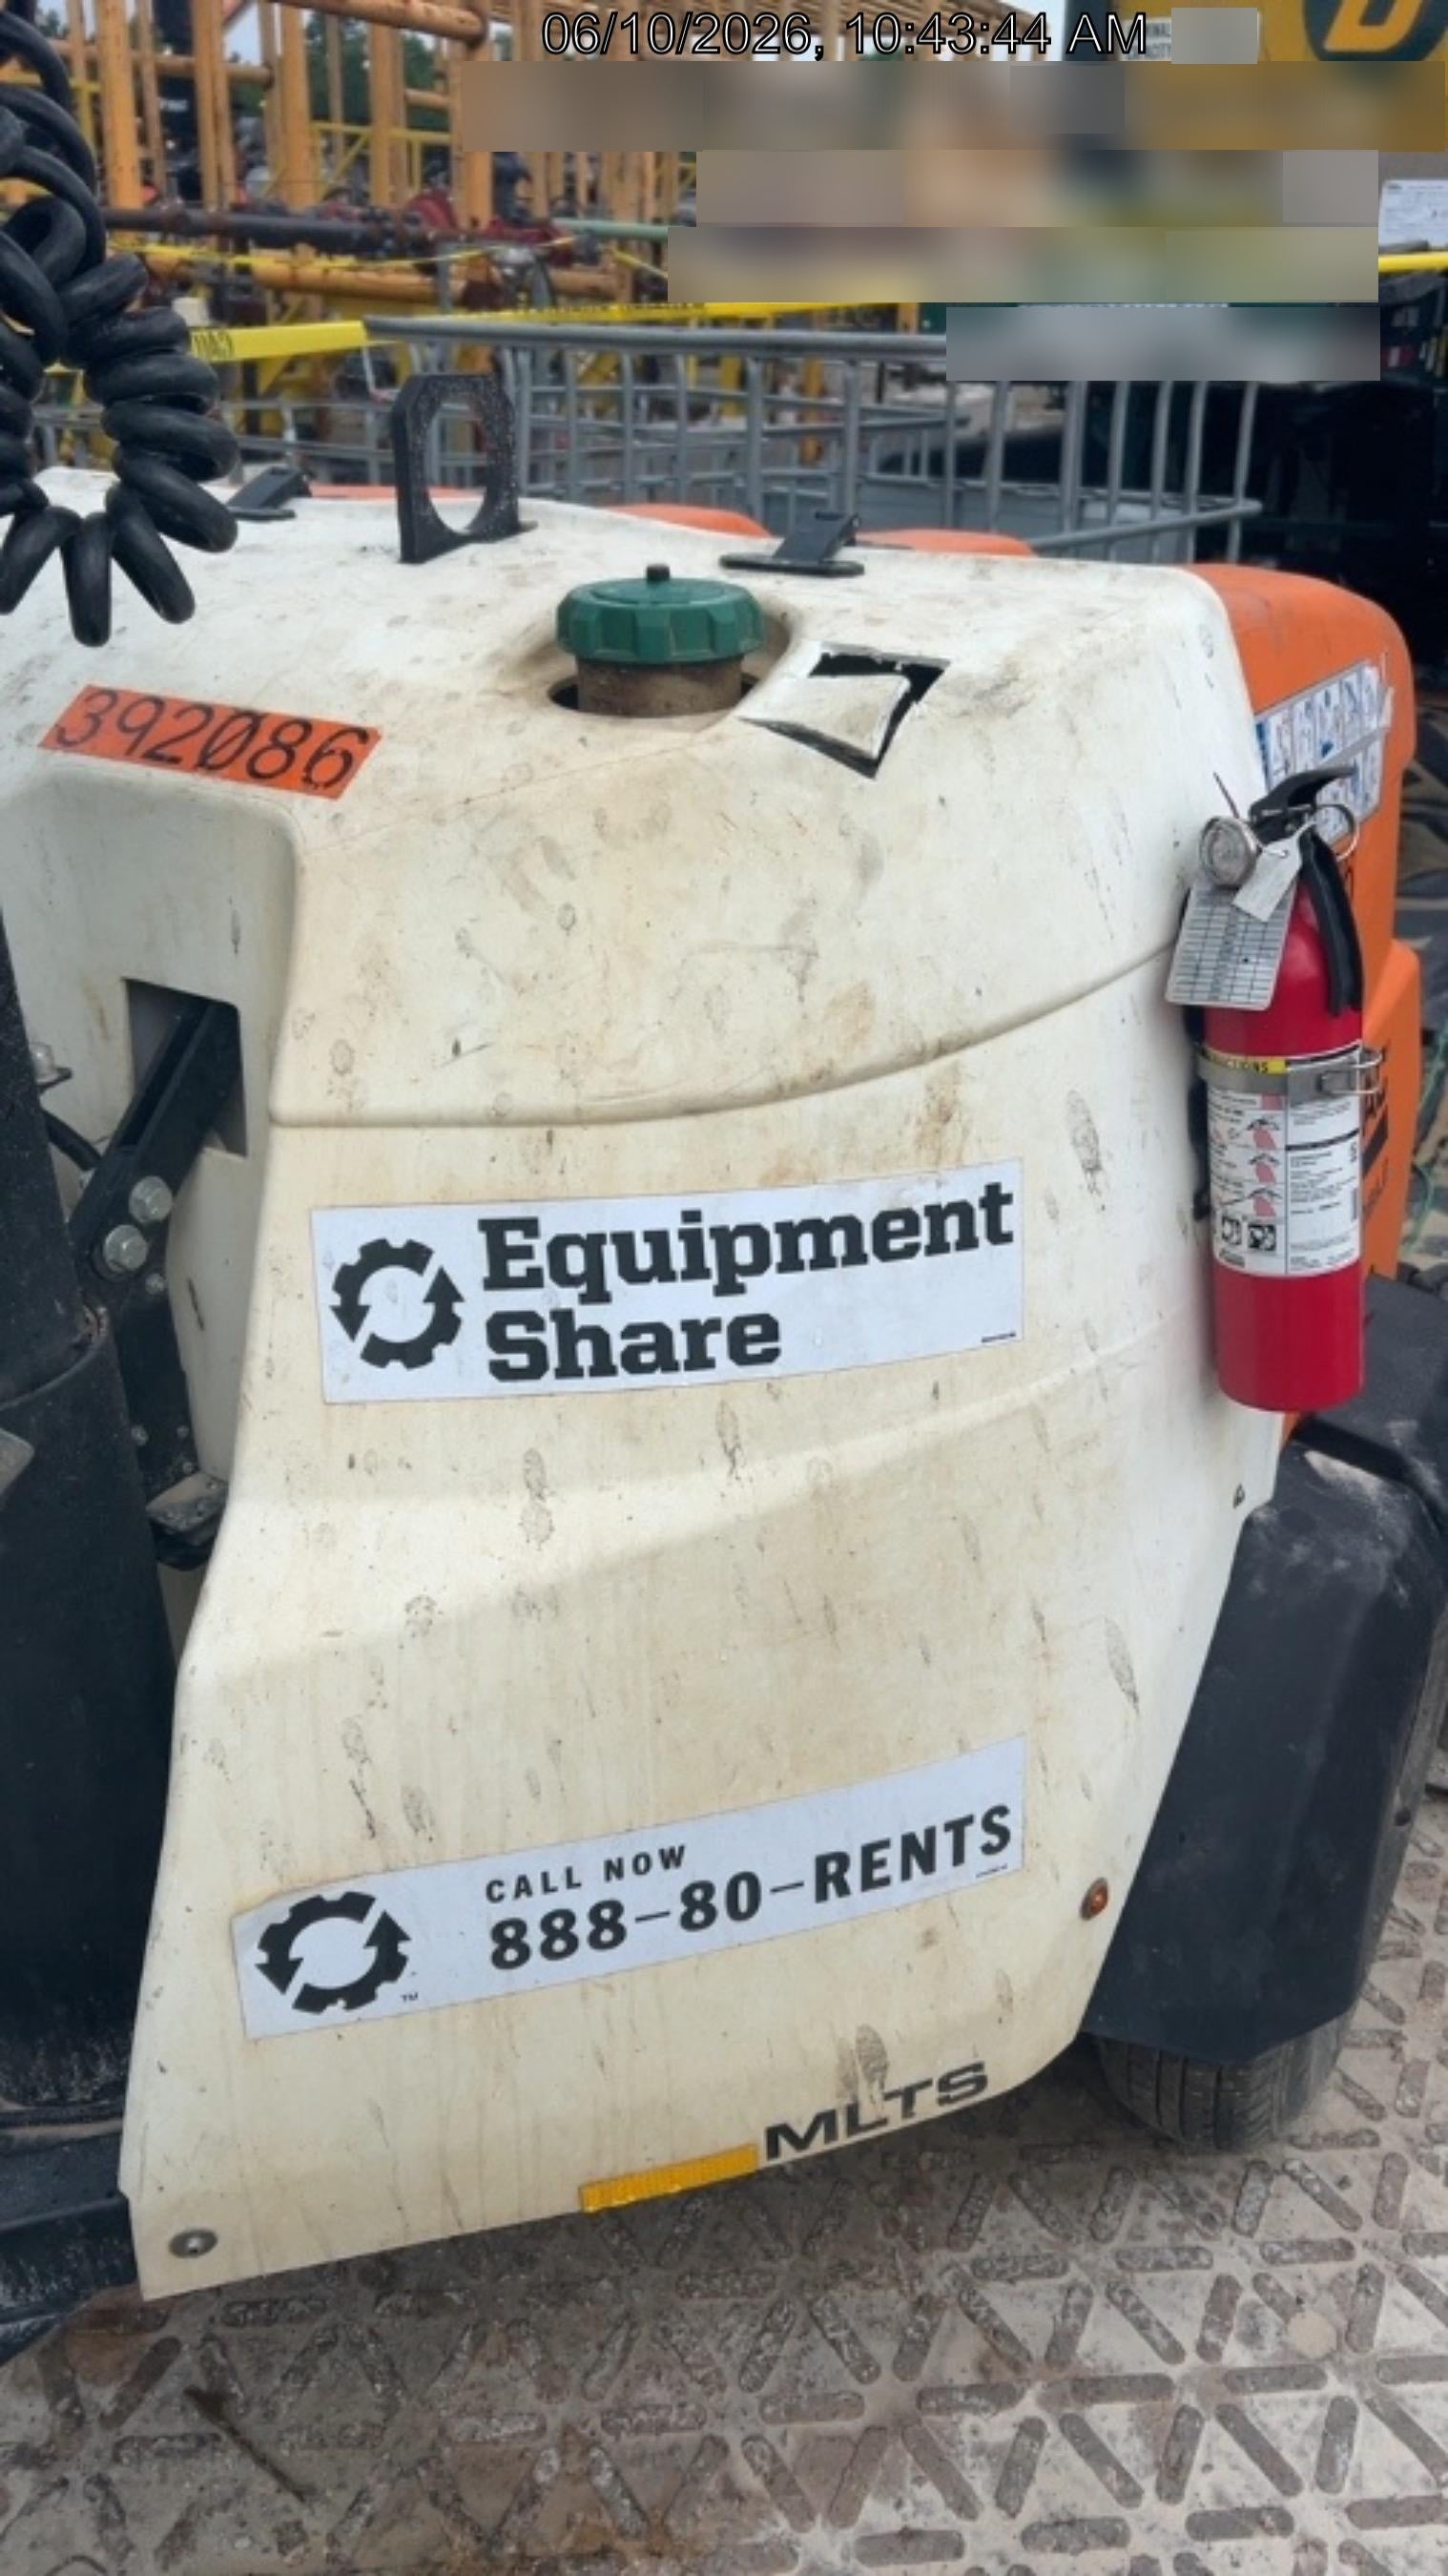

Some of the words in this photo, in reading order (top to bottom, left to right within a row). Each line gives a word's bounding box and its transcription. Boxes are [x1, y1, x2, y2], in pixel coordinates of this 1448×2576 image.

[55, 689, 368, 790] 392086
[479, 1182, 1014, 1305] Equipment
[486, 1309, 781, 1382] Share
[486, 1866, 582, 1903] CALL
[604, 1844, 686, 1882] NOW
[765, 2061, 988, 2161] MLTS
